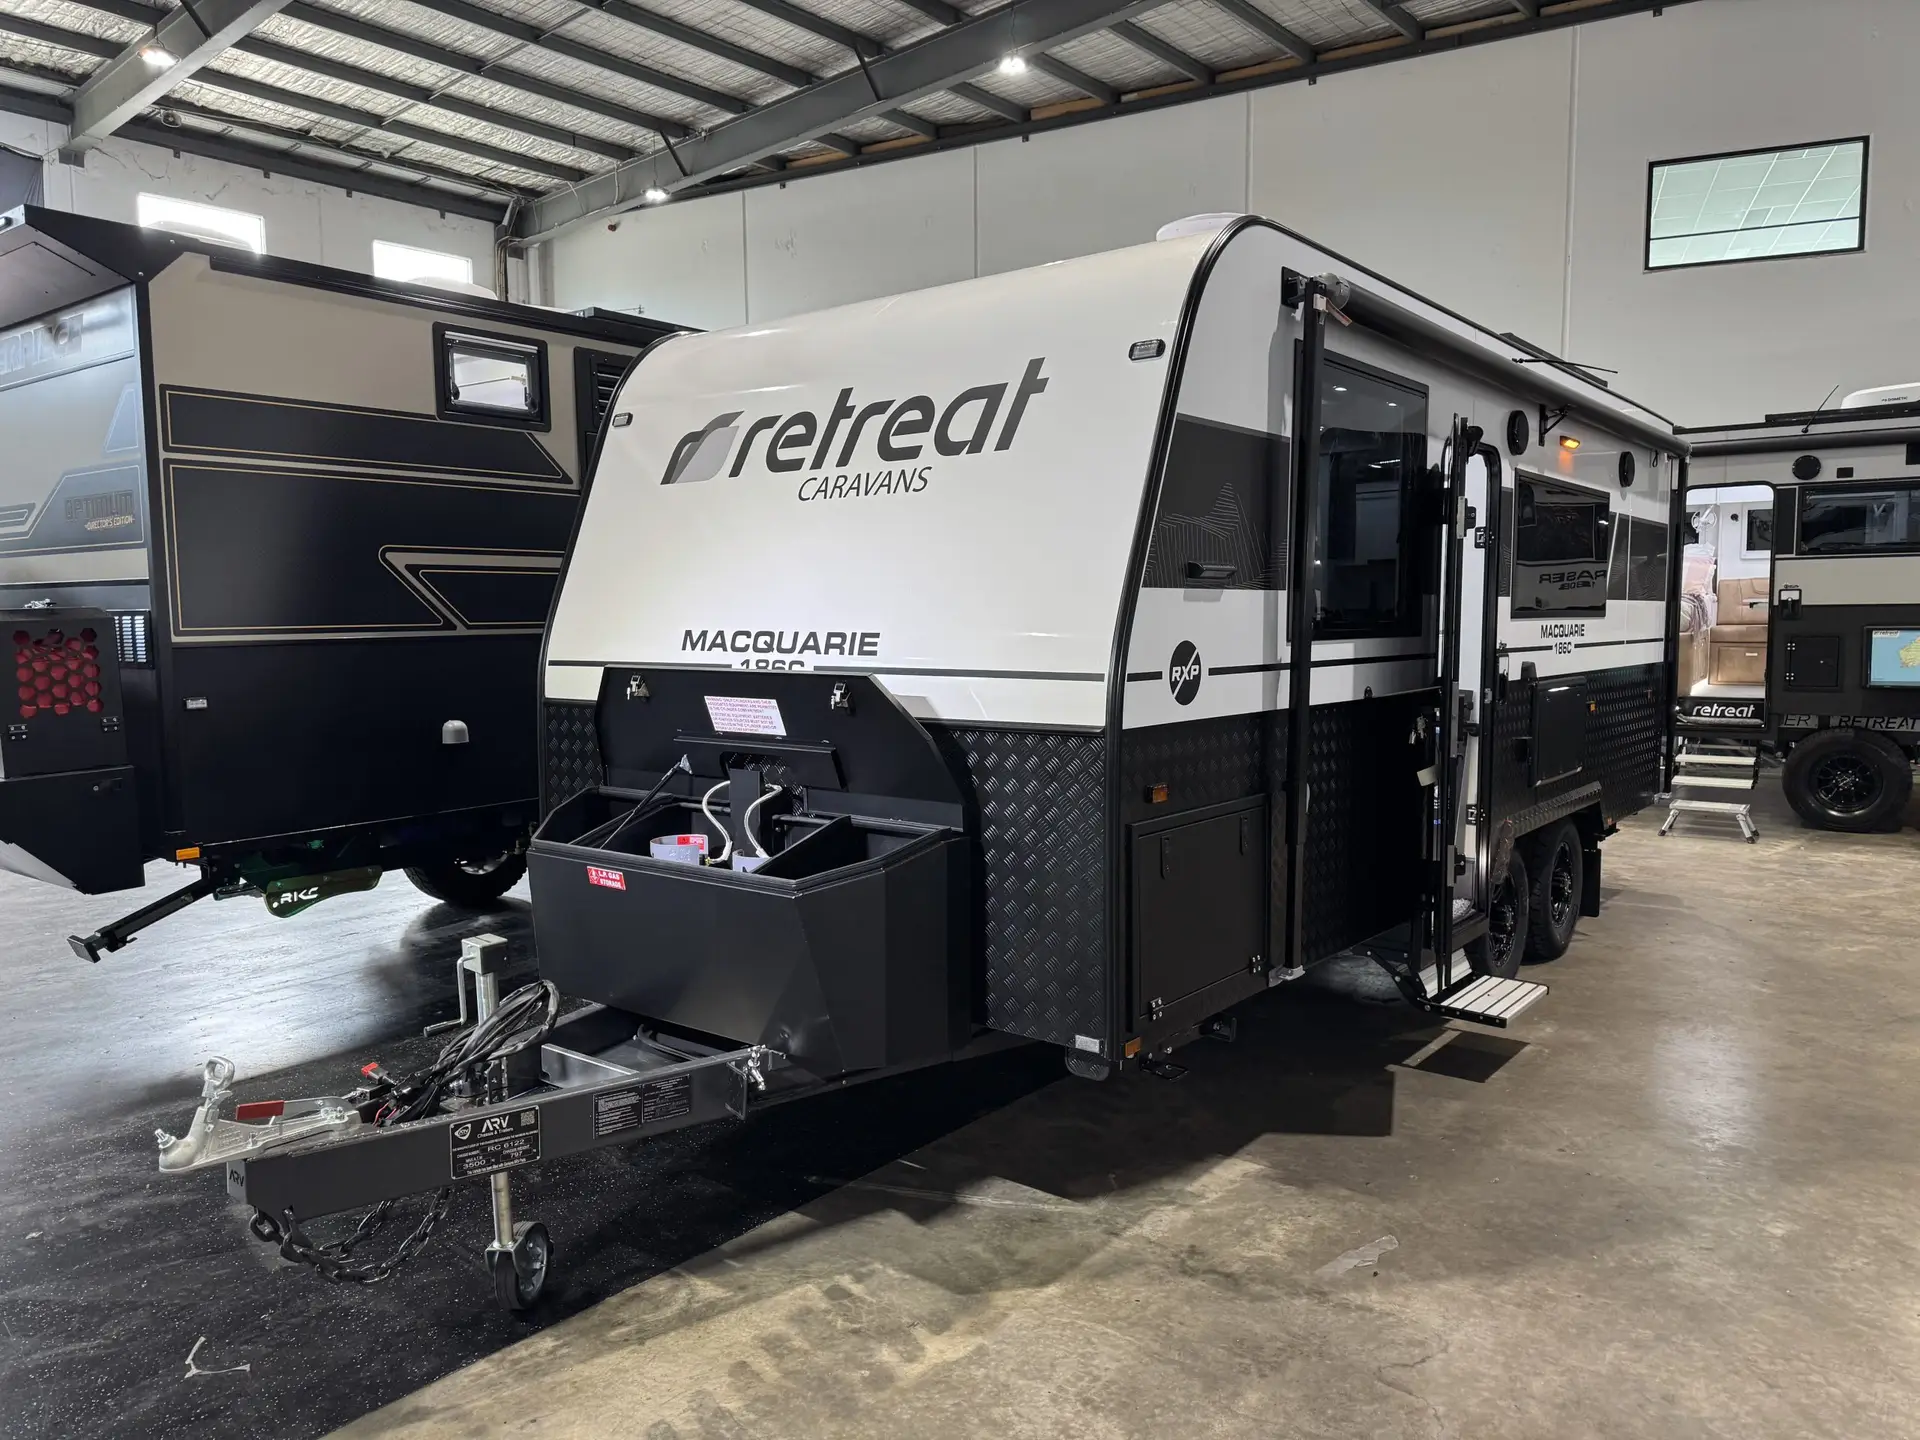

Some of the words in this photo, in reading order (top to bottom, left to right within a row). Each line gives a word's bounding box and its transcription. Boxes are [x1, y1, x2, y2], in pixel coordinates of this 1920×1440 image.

[728, 356, 1050, 478] retreat
[797, 466, 932, 501] CARAVANS
[113, 515, 133, 526] EDITION
[1540, 624, 1585, 639] MACQUARIE
[681, 629, 881, 657] MACQUARIE
[1554, 641, 1572, 655] 186C
[1172, 664, 1200, 682] RXP
[1692, 703, 1756, 718] retreat
[482, 1115, 509, 1133] ARV
[503, 1139, 525, 1149] 6122
[463, 1160, 486, 1170] 3500
[229, 1169, 244, 1187] ARV
